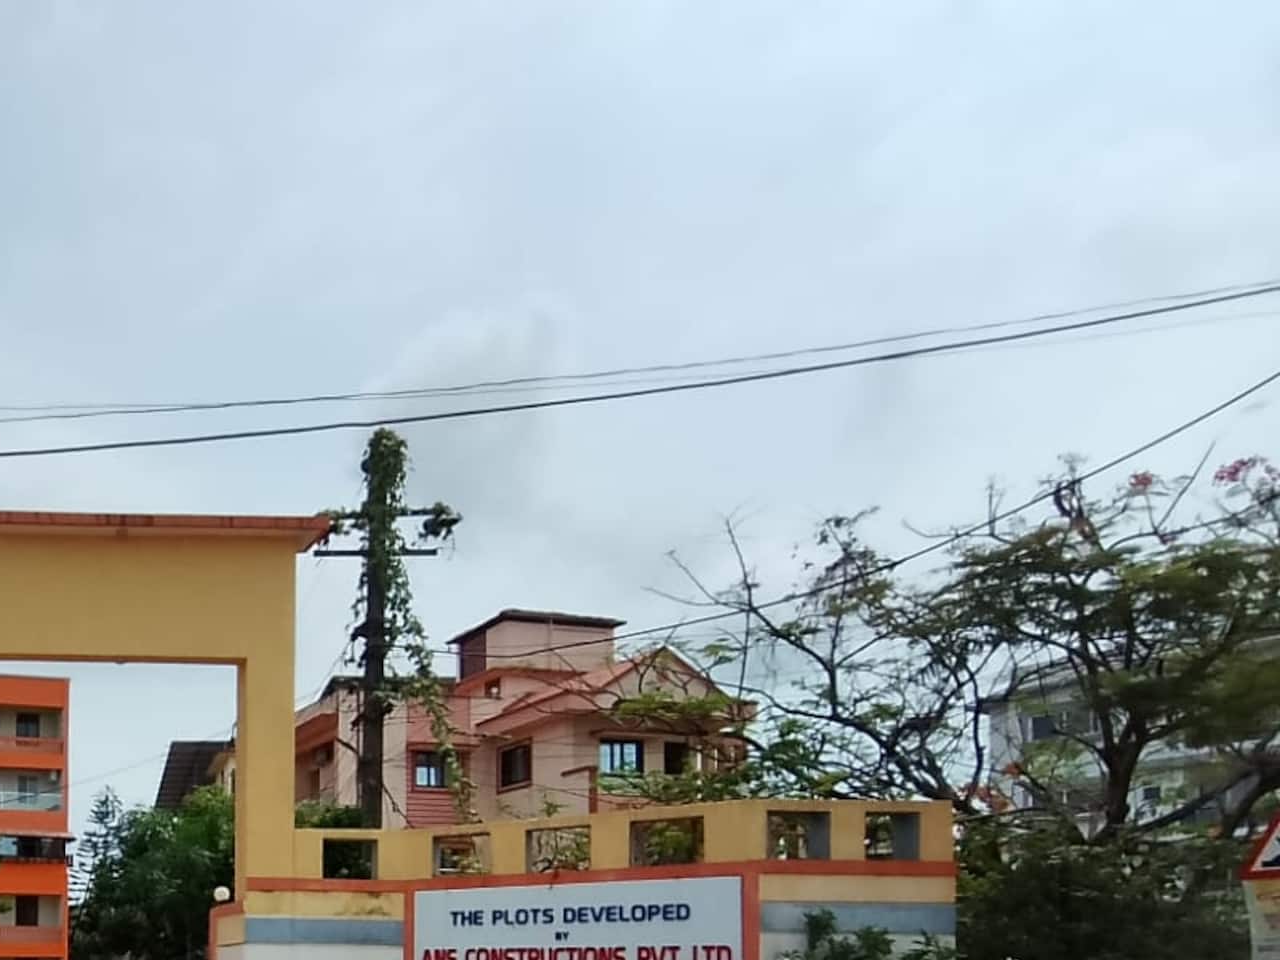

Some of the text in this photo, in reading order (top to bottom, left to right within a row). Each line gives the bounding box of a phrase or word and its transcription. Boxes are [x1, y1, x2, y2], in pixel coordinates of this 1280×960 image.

[450, 903, 690, 926] THE PLOTS DEVELOPED
[555, 931, 569, 941] BY
